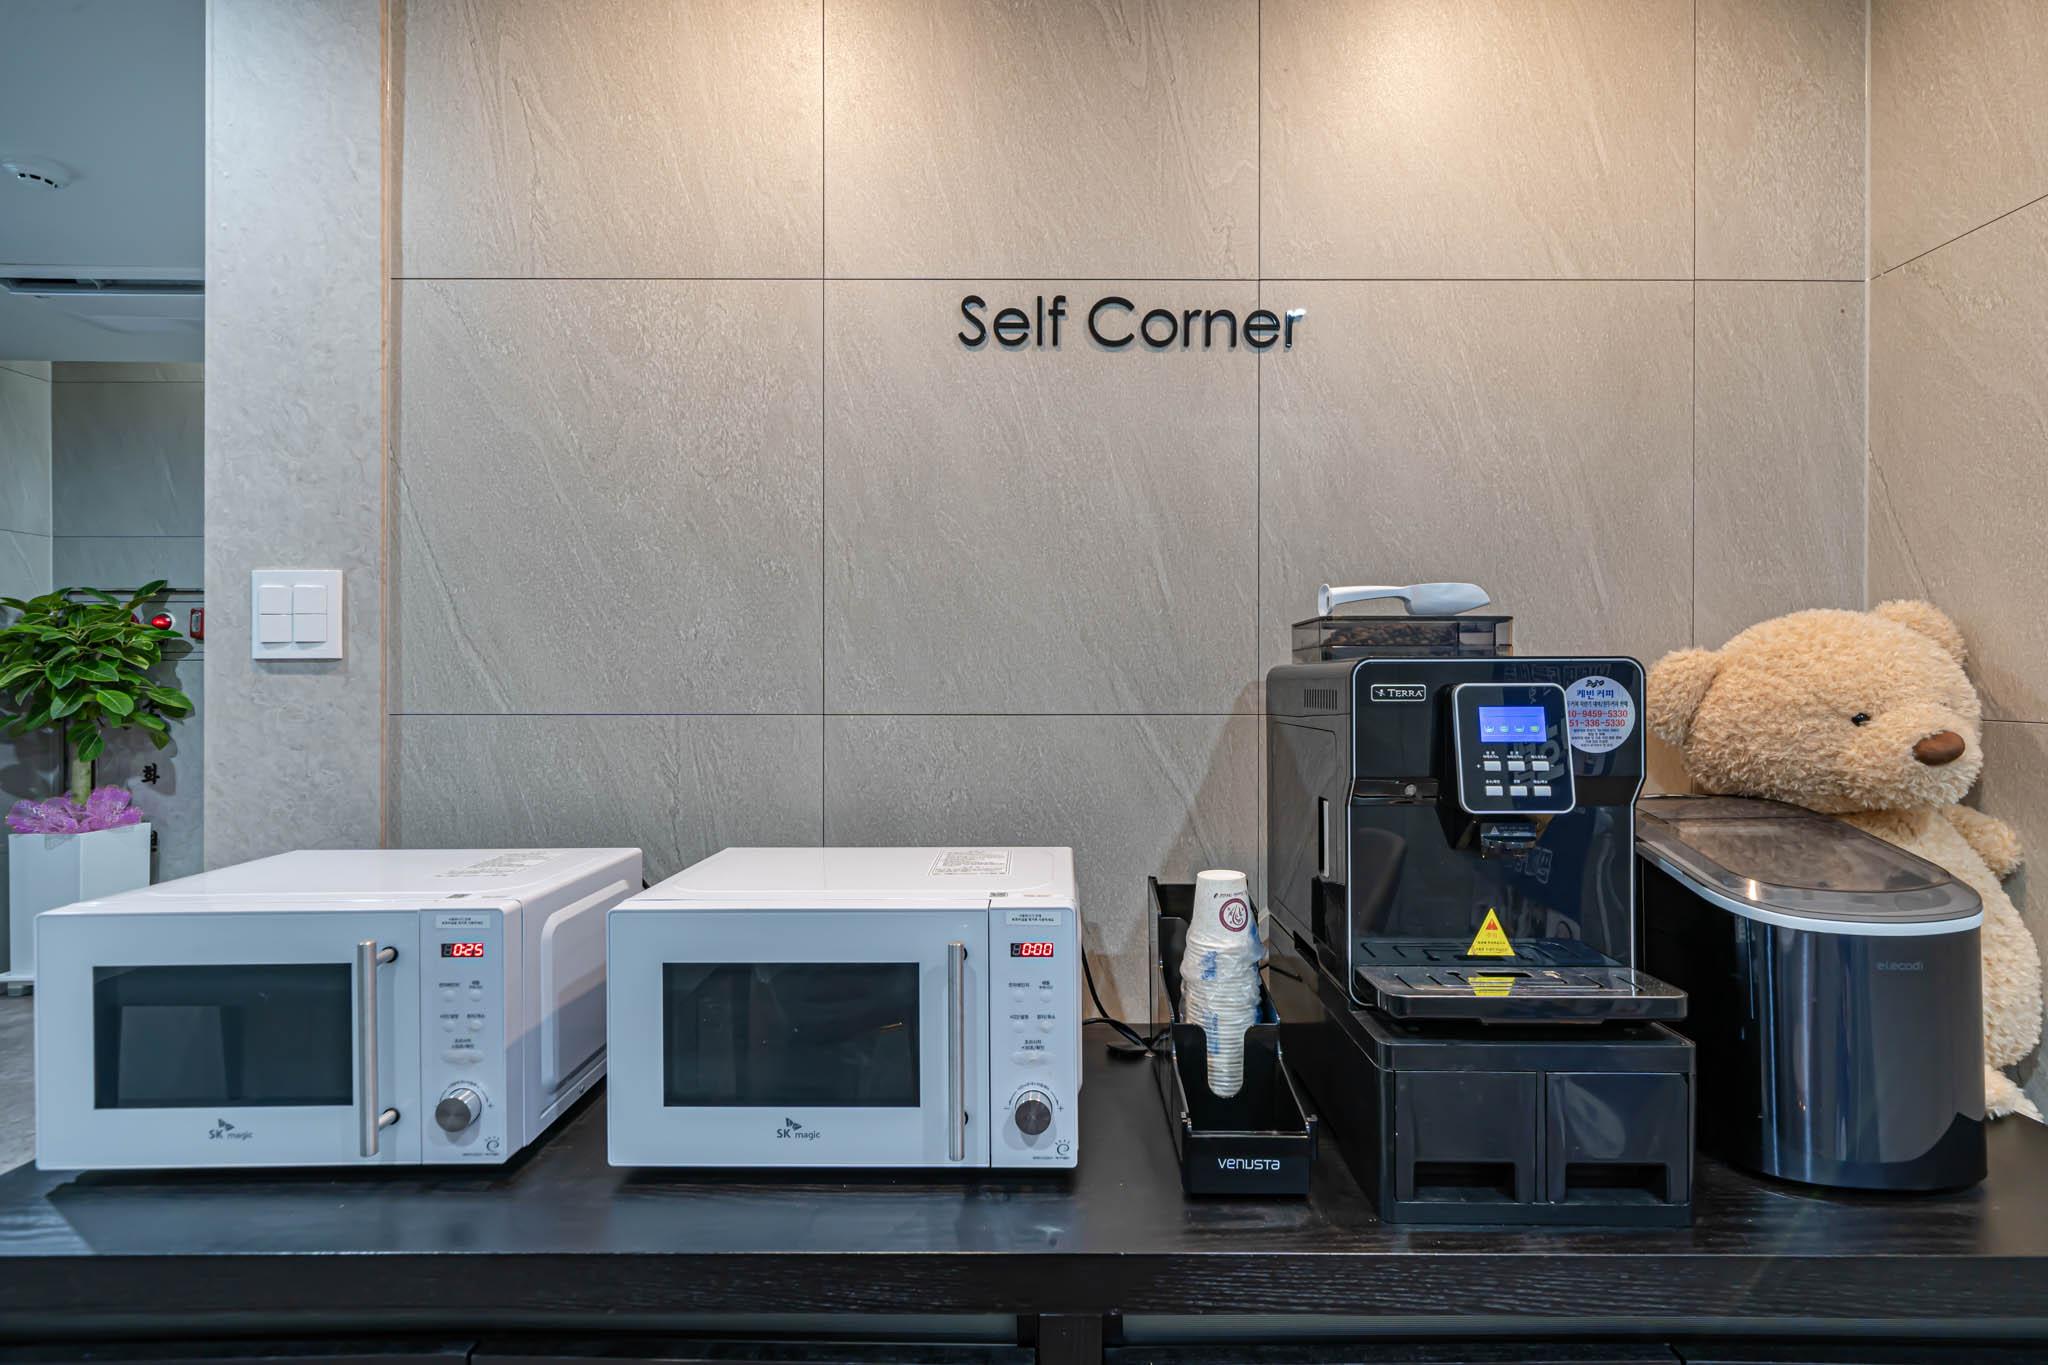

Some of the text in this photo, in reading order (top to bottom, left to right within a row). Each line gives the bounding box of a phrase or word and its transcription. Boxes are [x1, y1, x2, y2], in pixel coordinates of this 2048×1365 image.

[957, 294, 1304, 348] Self Corner
[1386, 688, 1423, 697] TERRA
[1597, 689, 1614, 699] 커피
[141, 763, 160, 785] 화
[1021, 943, 1053, 956] 0:00
[208, 1129, 223, 1140] SK
[776, 1128, 821, 1141] SK magic
